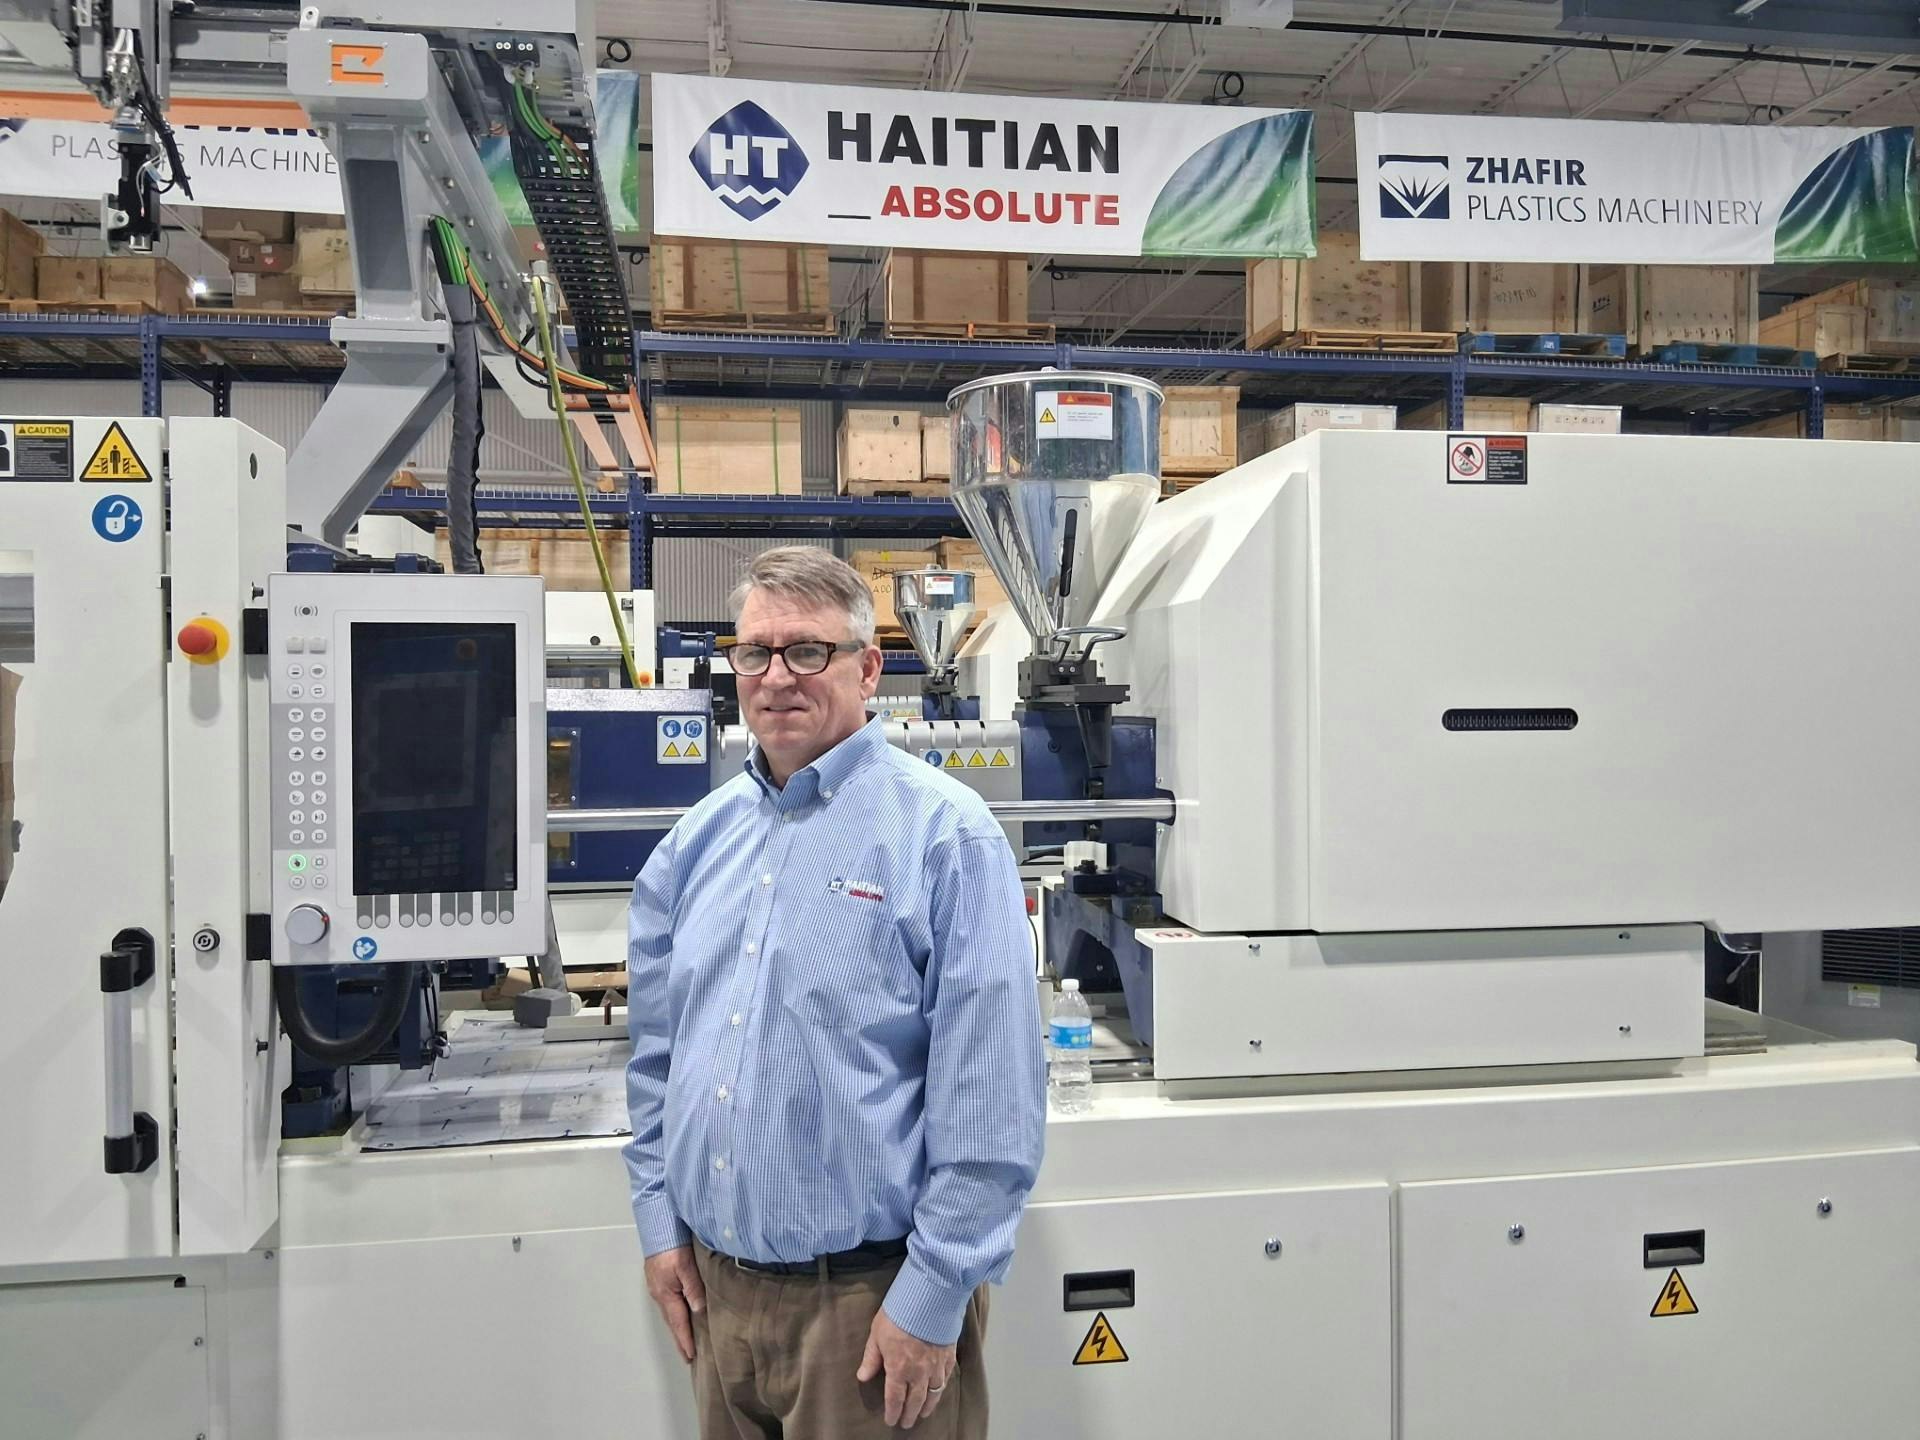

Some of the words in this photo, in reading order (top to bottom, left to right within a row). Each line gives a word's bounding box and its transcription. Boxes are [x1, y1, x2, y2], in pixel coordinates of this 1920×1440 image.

[709, 132, 789, 179] HT
[827, 110, 1120, 174] HAITIAN
[199, 144, 337, 175] MACHINE
[1465, 156, 1587, 186] ZHAFIR
[880, 184, 1120, 226] ABSOLUTE
[1467, 194, 1587, 223] PLASTICS
[1598, 198, 1763, 225] MACHINERY
[27, 426, 68, 434] CAUTION
